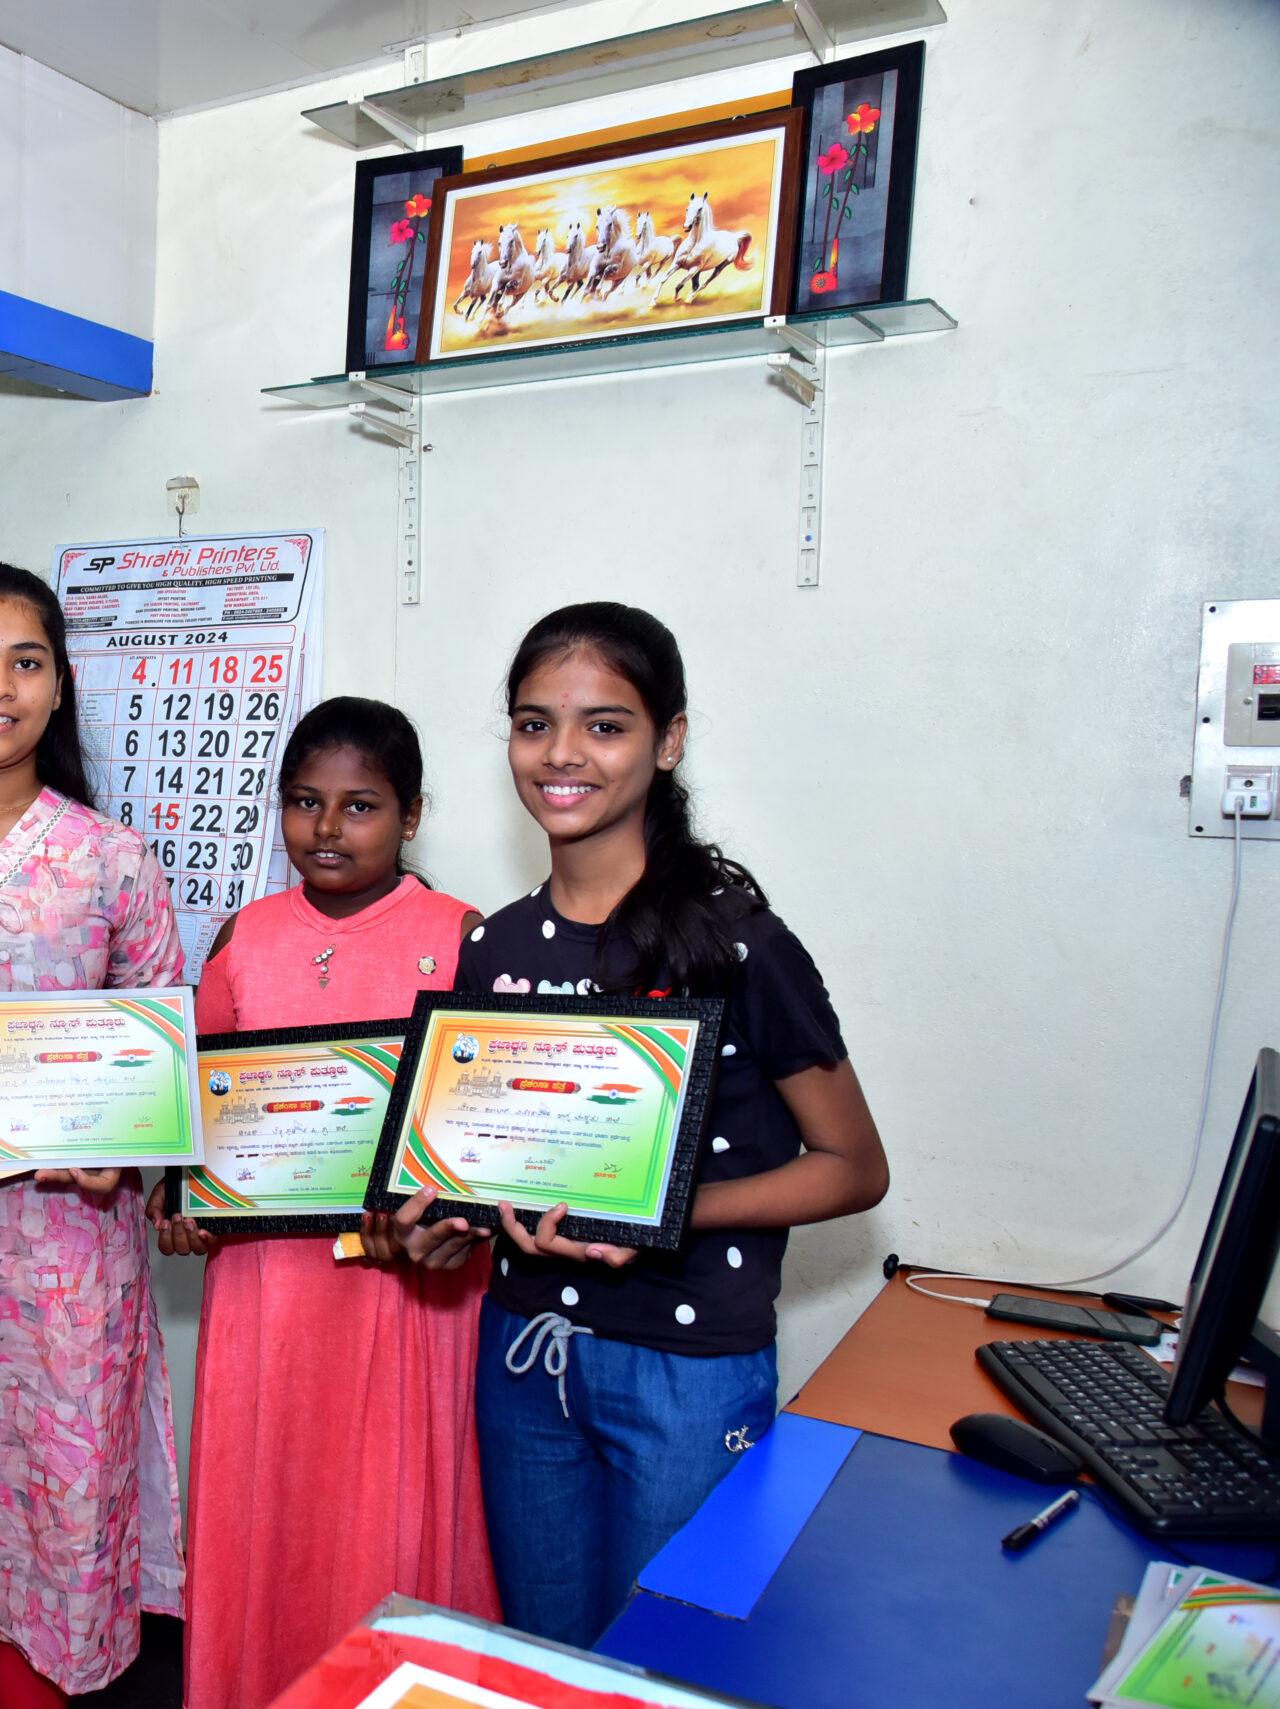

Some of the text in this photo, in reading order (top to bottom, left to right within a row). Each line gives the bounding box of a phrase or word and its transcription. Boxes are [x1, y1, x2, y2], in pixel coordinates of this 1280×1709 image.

[82, 556, 115, 574] SP
[197, 544, 279, 565] Printers
[172, 564, 233, 577] Publishers
[107, 631, 228, 648] AUGUST 2024
[131, 654, 284, 685] 4 11 18 25
[128, 694, 143, 721] 5
[162, 693, 192, 721] 12
[204, 693, 235, 721] 19
[246, 692, 280, 721] 26
[125, 730, 139, 757] 6
[158, 729, 187, 758] 13
[198, 729, 230, 758] 20
[241, 730, 276, 759] 27
[123, 766, 266, 796] 7 14 21 28
[120, 802, 260, 834] 8 15 22 29
[150, 839, 254, 872] 16 23 30
[186, 878, 214, 906] 24
[225, 879, 245, 909] 31
